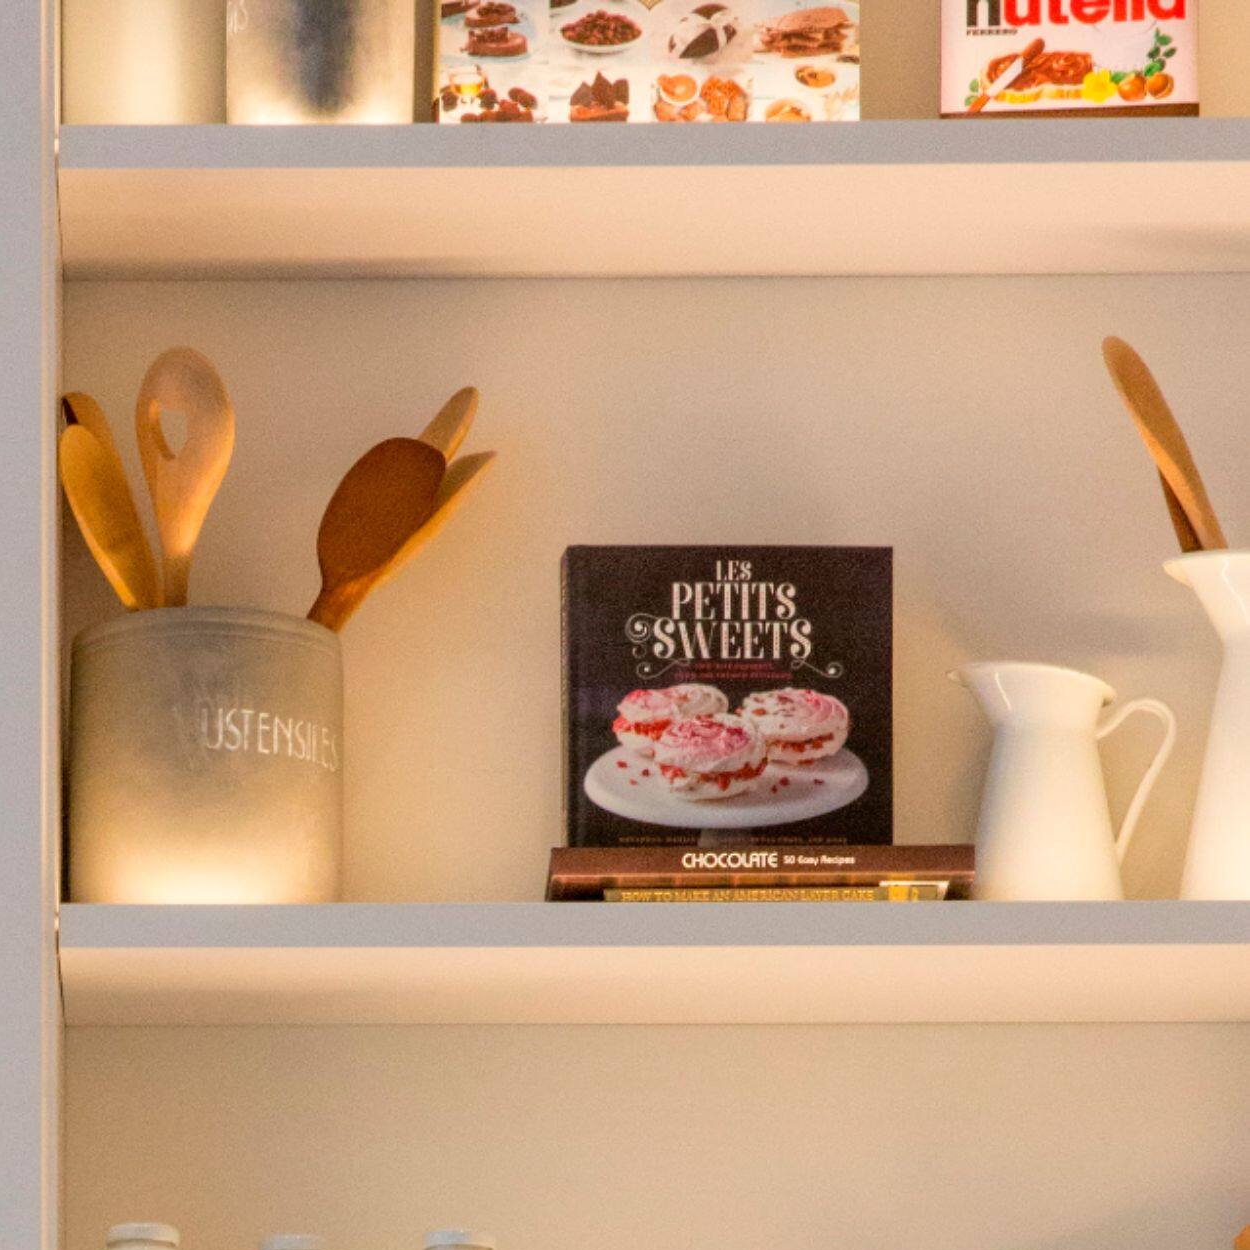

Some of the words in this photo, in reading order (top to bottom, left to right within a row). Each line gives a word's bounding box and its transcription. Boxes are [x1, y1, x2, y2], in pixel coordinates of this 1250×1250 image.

[715, 559, 753, 581] LES
[671, 582, 797, 620] PETITS
[652, 616, 813, 660] SWEETS
[202, 707, 340, 772] USTENSILES
[681, 852, 779, 869] CHOCOLATE
[783, 855, 796, 864] 50
[798, 855, 819, 867] Easy
[820, 855, 856, 866] Recipes
[654, 891, 672, 901] TO
